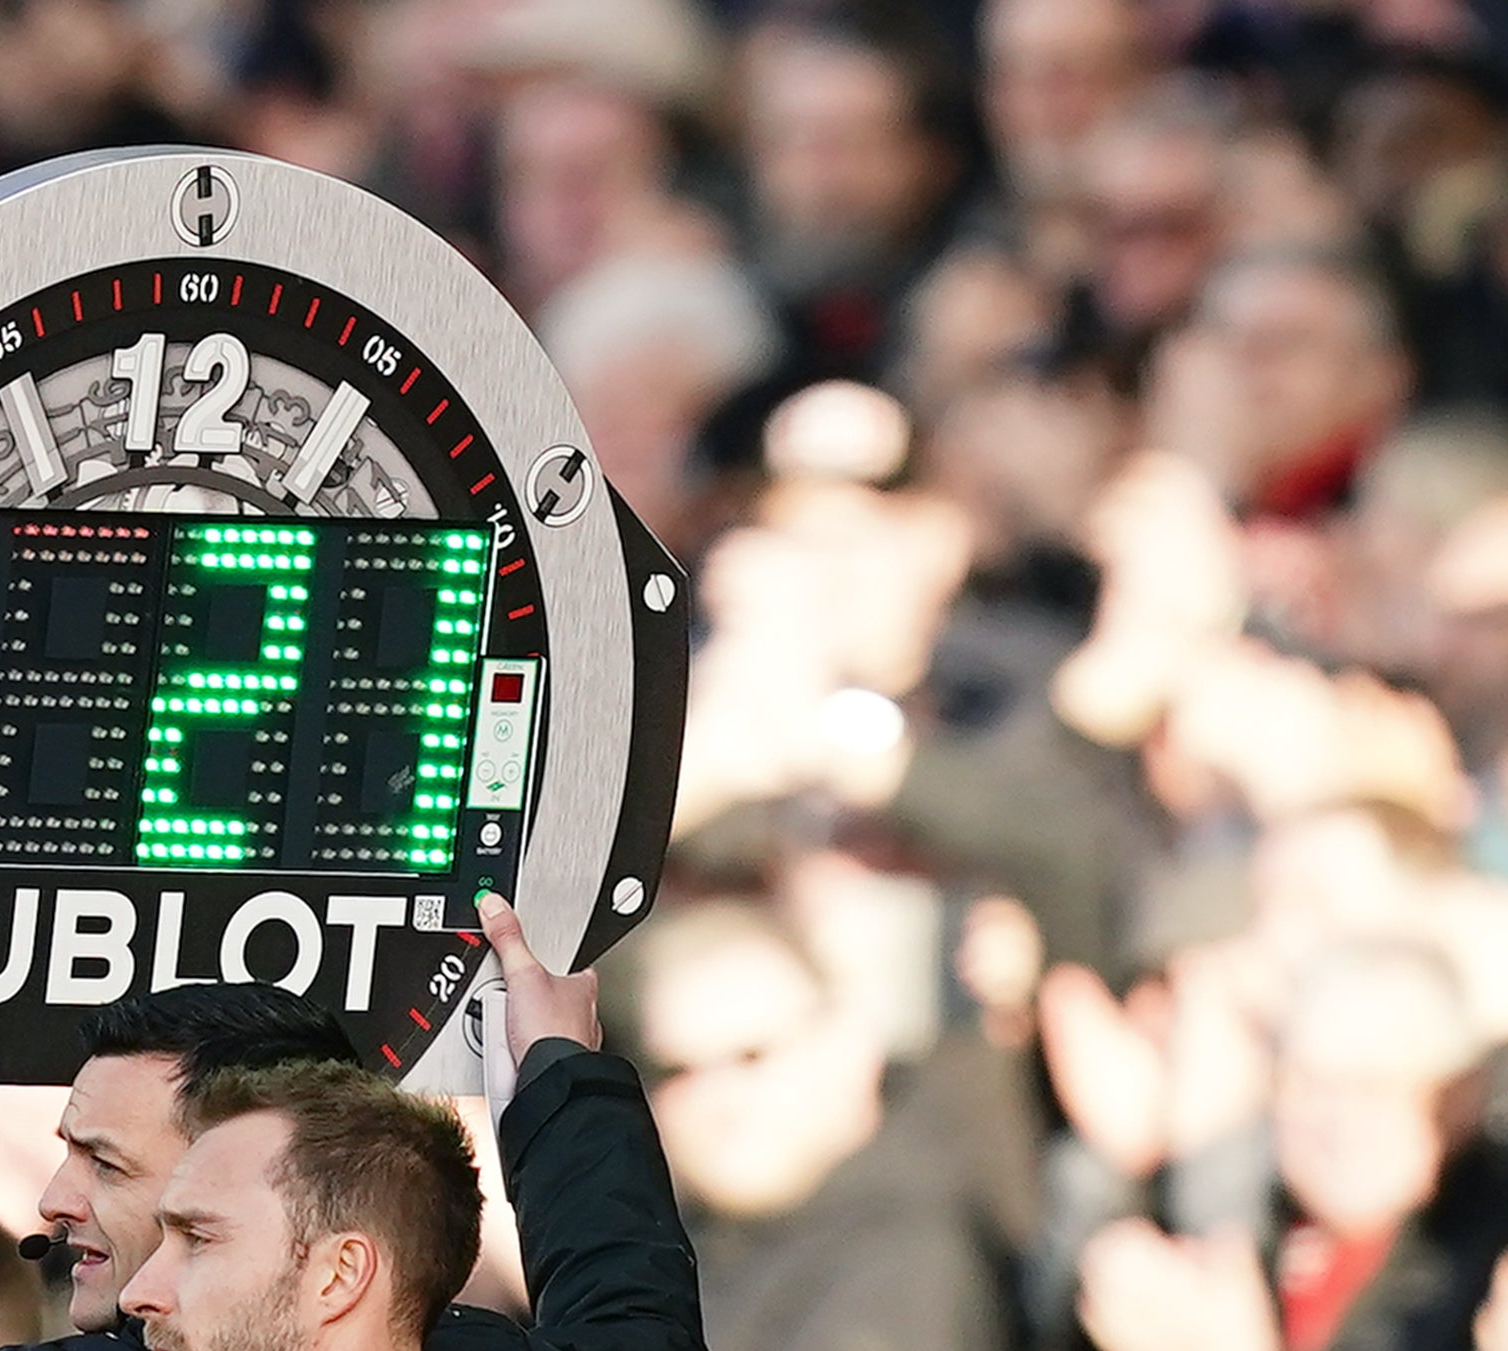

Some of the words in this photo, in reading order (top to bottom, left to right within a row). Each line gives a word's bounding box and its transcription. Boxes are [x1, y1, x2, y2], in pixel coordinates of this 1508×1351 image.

[181, 273, 220, 302] 60
[362, 335, 403, 377] 05
[111, 332, 252, 453] 12
[135, 524, 485, 867] 21
[428, 953, 467, 1004] 20
